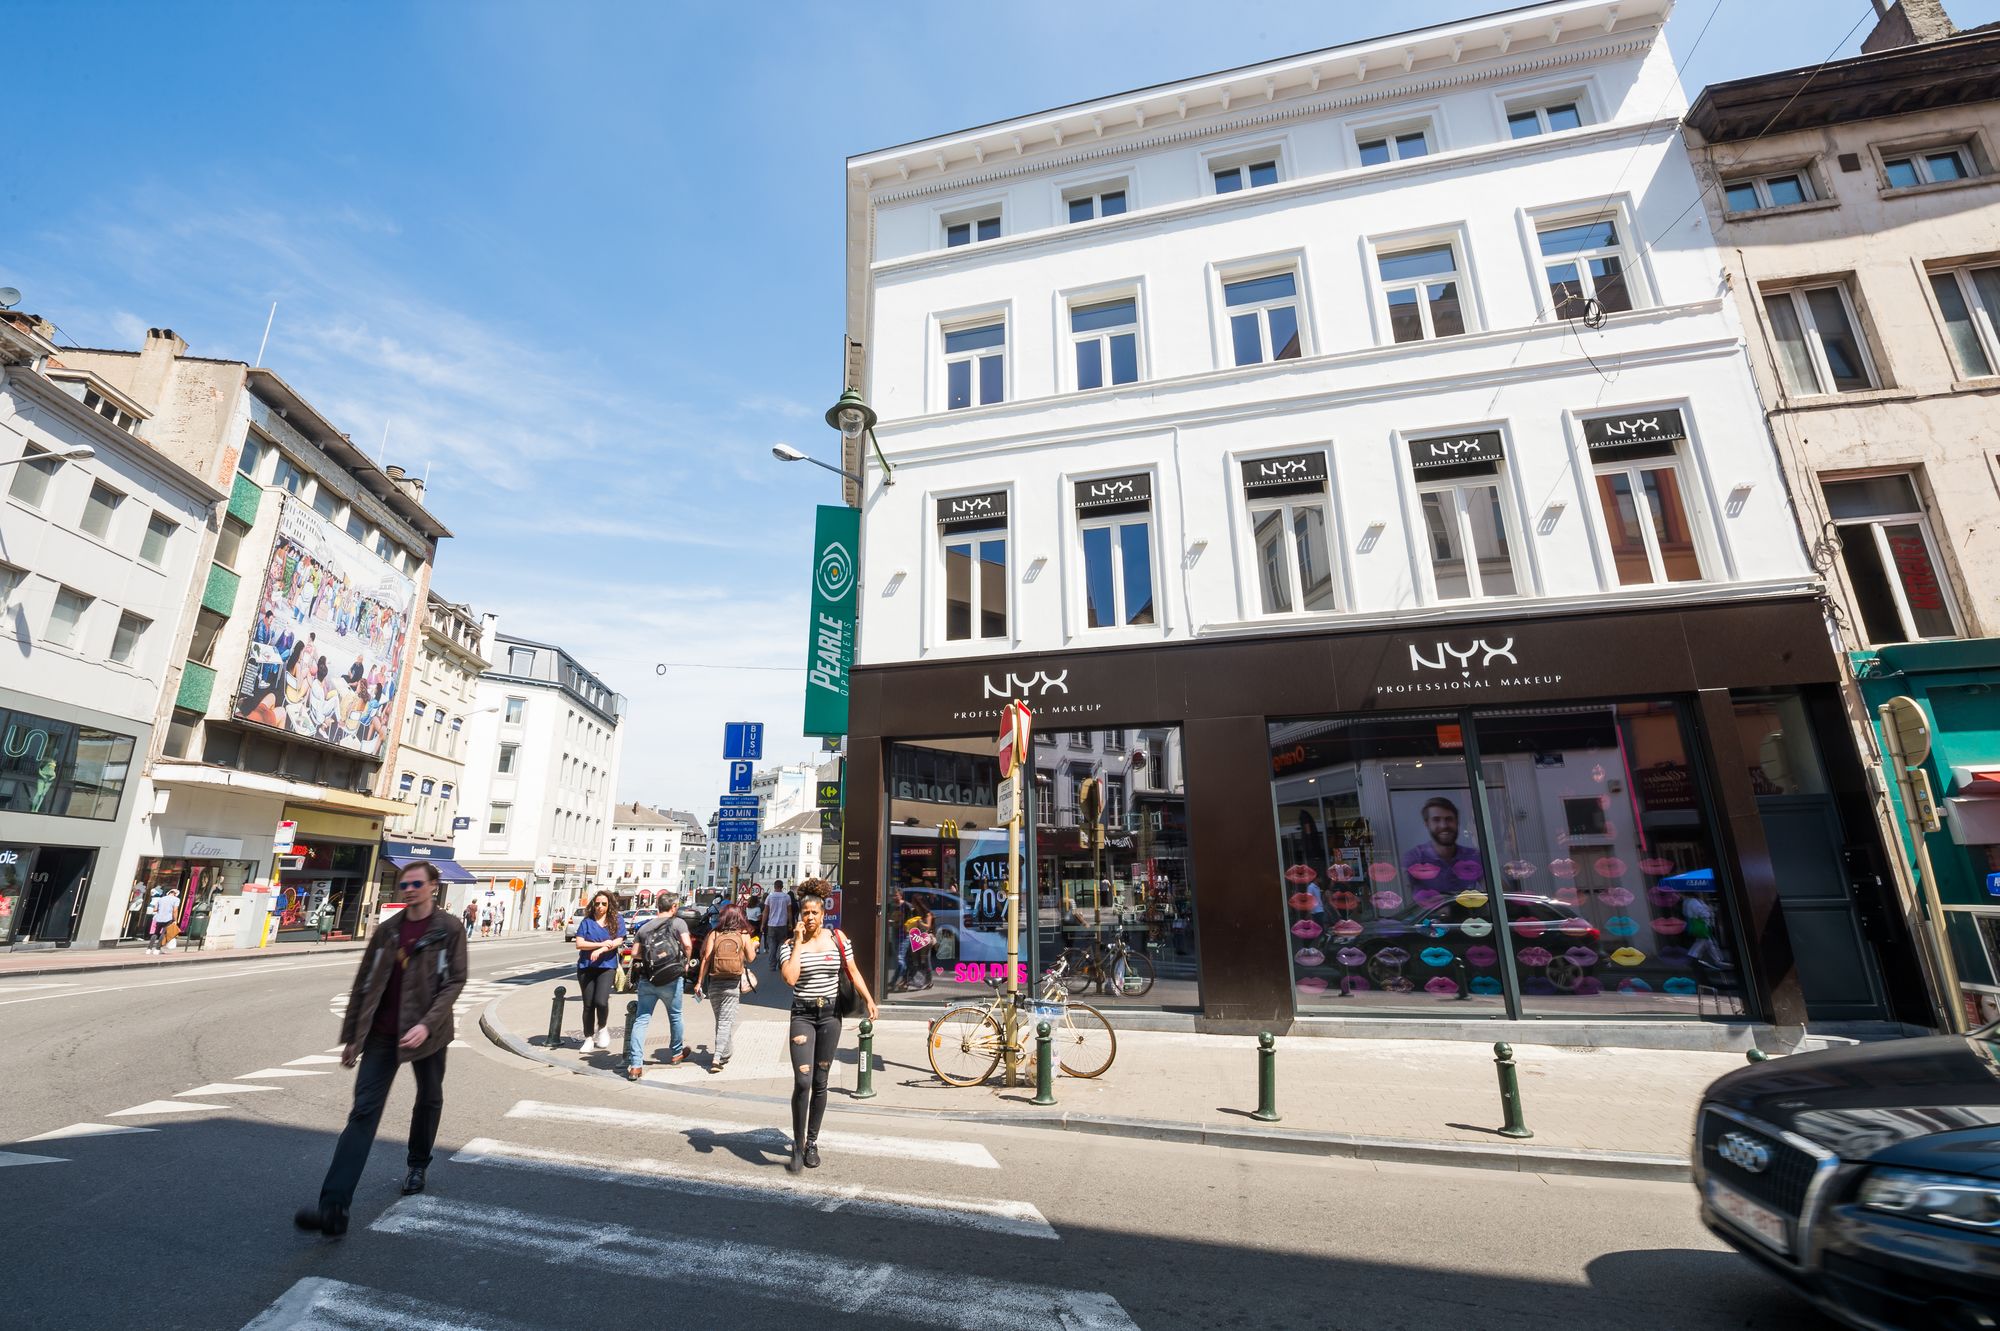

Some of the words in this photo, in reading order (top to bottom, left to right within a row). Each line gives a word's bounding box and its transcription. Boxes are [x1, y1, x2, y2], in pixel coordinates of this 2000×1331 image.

[1605, 417, 1659, 436] NYX
[1430, 438, 1480, 456] NYX
[1590, 437, 1646, 447] PROFESSIONAL
[1261, 459, 1306, 476] NYX
[1415, 457, 1468, 467] PROFESSIONAL
[1472, 453, 1501, 461] MAKEUP
[1091, 480, 1133, 497] NYX
[1246, 477, 1295, 486] PROFESSIONAL
[952, 497, 991, 513] NYX
[1077, 498, 1122, 507] PROFESSIONAL
[809, 612, 843, 693] PEARLE
[840, 622, 851, 696] OPTICIENS
[1409, 637, 1518, 671] NYX
[984, 669, 1068, 699] NYX
[1377, 679, 1491, 694] PROFESSIONAL
[1501, 675, 1562, 687] MAKEUP
[954, 707, 1045, 719] PROFESSAL
[1053, 703, 1102, 714] MAKEUP
[735, 763, 748, 781] P
[722, 809, 734, 817] 30
[190, 841, 221, 856] Etam
